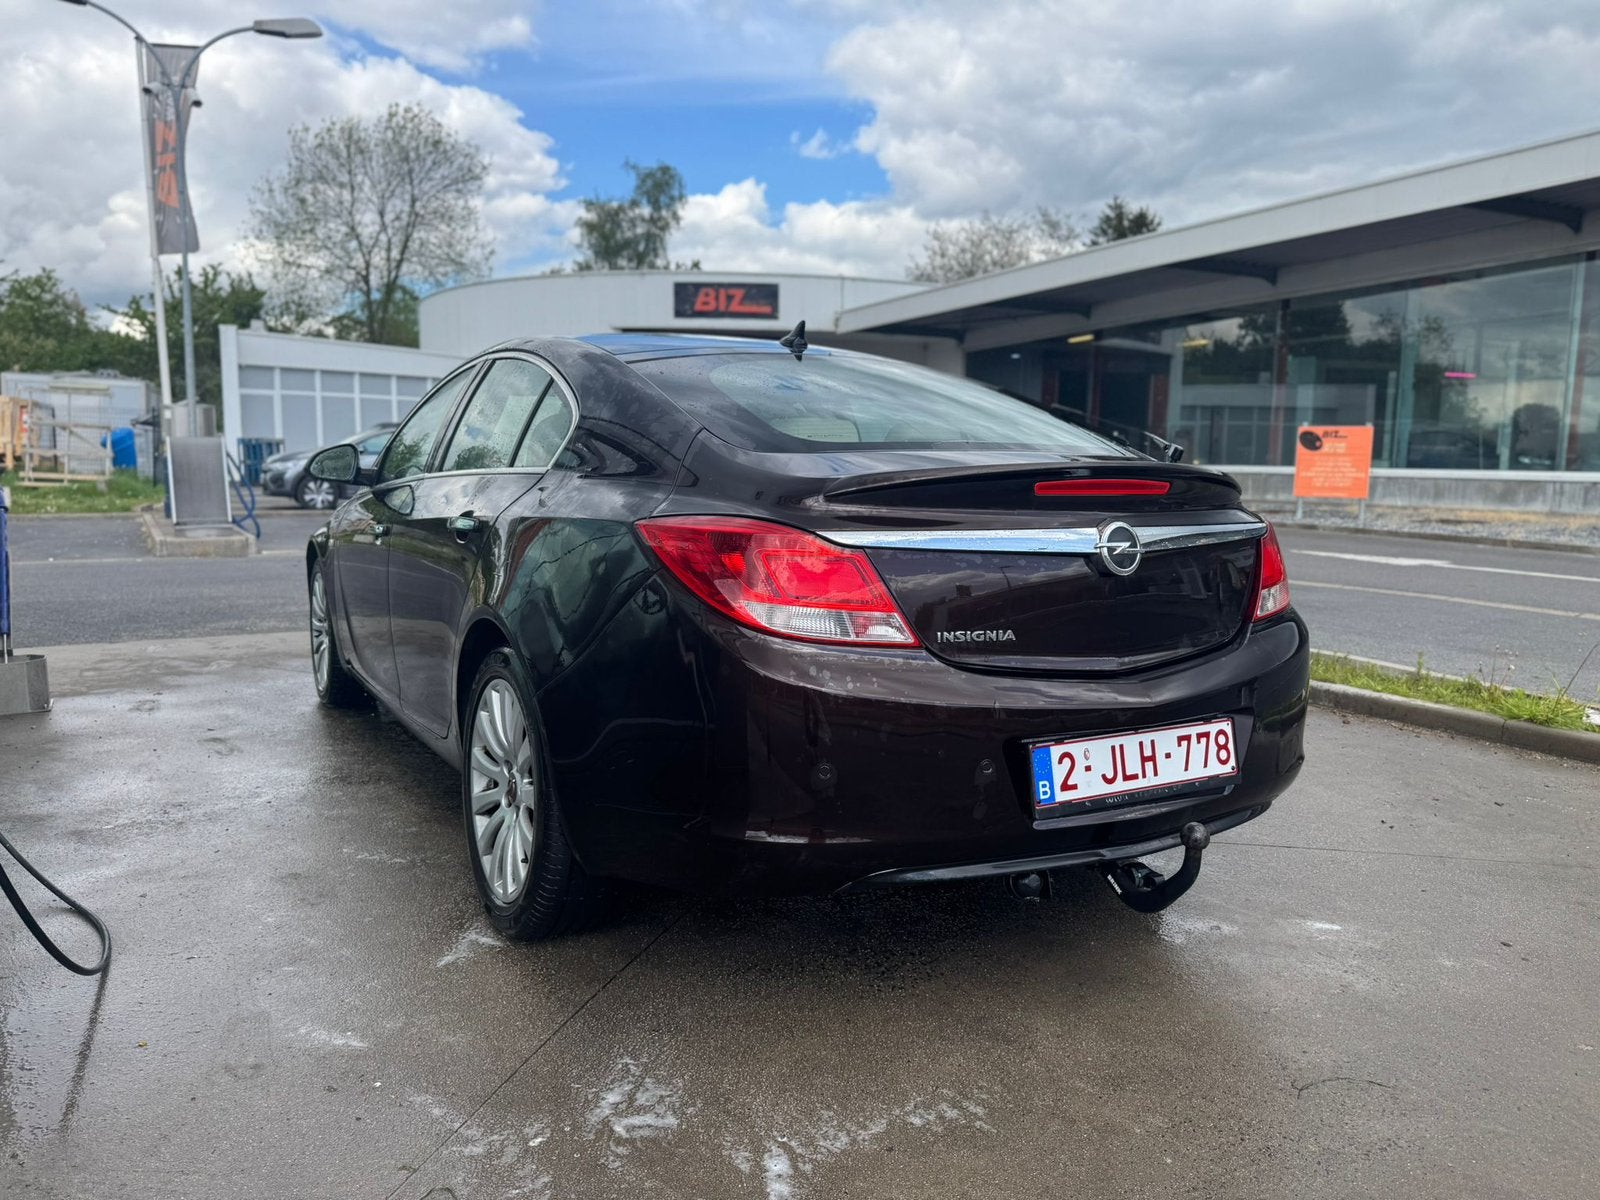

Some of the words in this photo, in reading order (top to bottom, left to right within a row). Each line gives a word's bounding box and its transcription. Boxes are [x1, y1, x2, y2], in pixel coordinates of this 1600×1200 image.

[694, 287, 772, 314] BIZ
[936, 629, 1016, 643] INSIGNIA
[1057, 728, 1231, 793] 2-JLH-778
[1039, 780, 1051, 800] B
